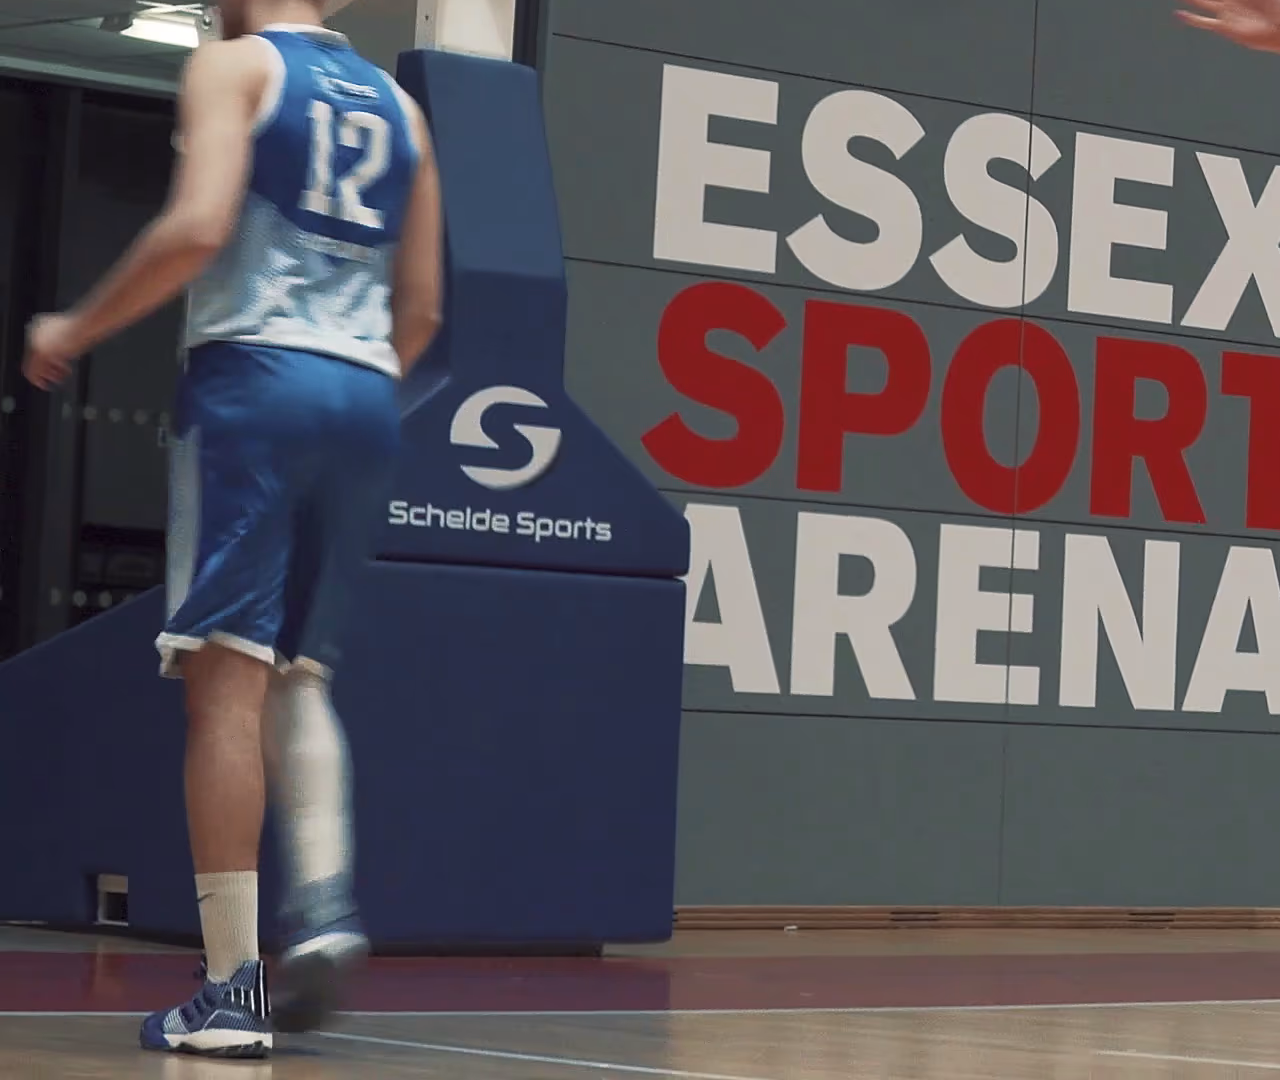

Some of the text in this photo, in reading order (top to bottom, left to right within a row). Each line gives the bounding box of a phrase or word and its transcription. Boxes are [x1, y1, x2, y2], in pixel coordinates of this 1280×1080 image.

[298, 98, 392, 230] 12
[388, 500, 612, 543] Schelde Sports
